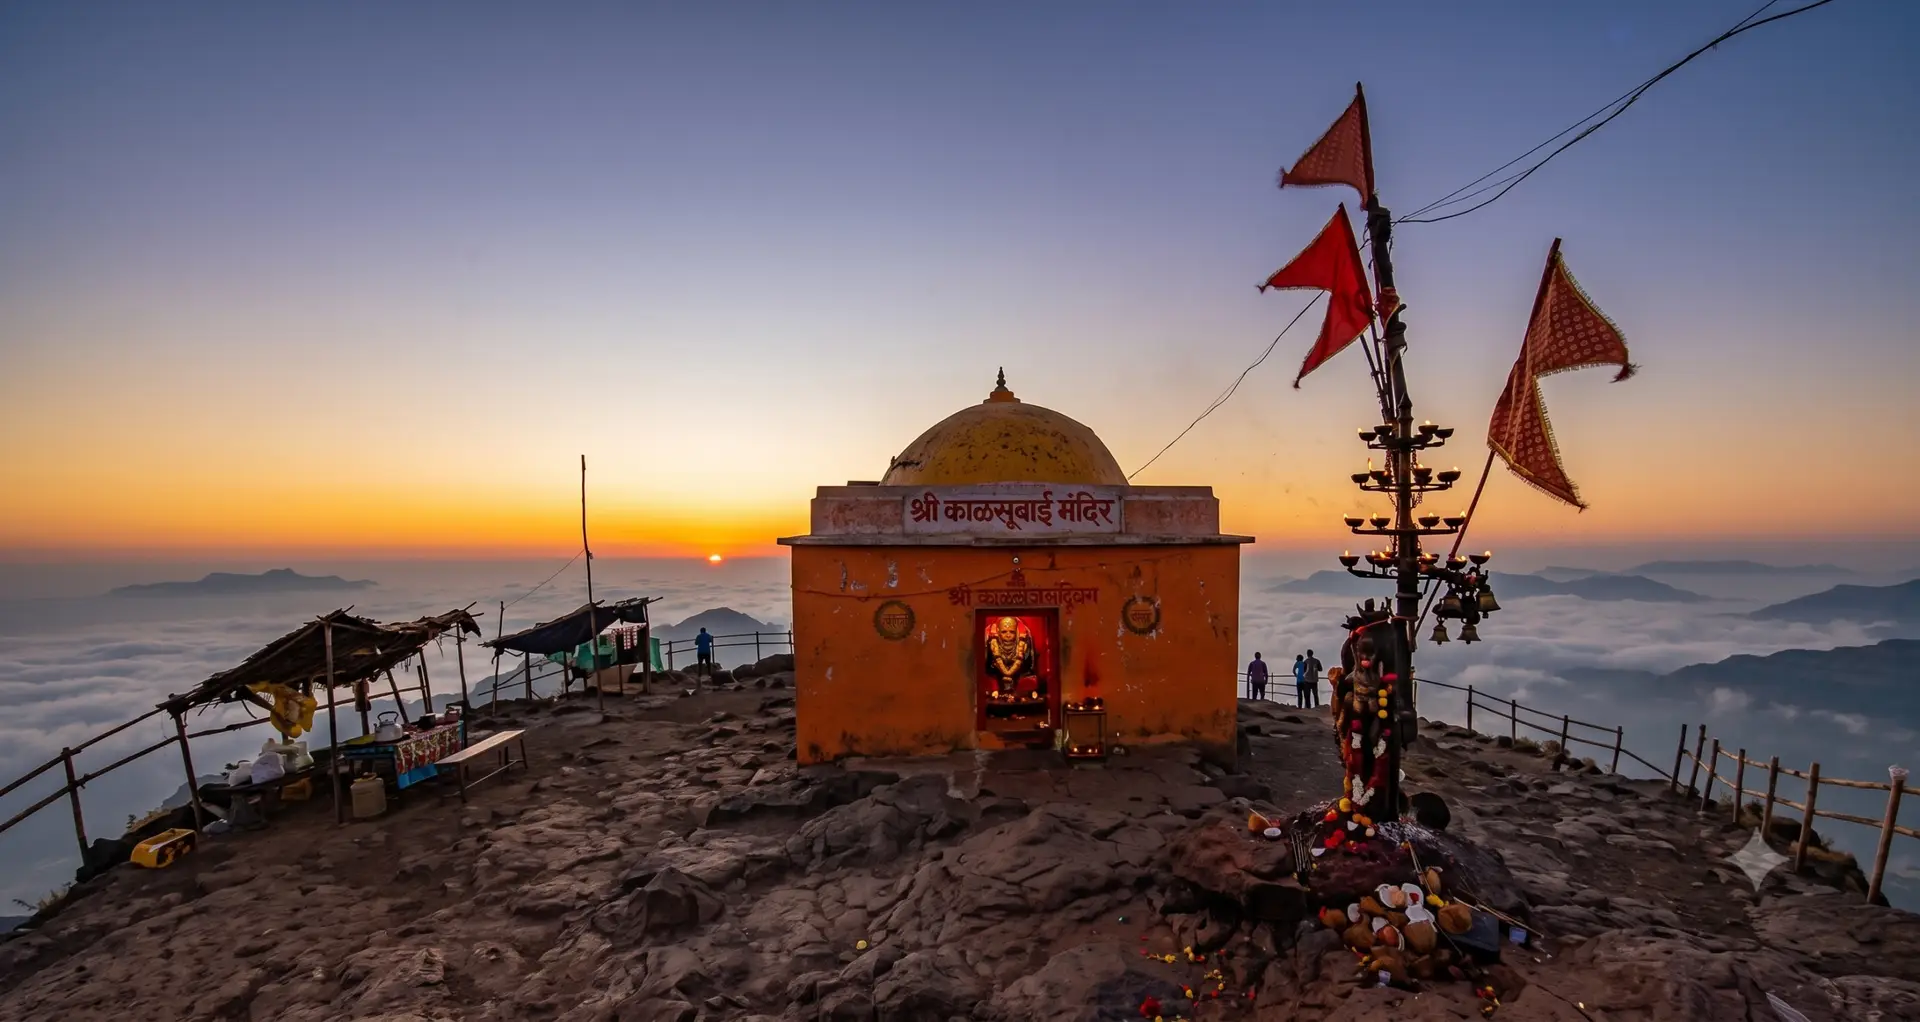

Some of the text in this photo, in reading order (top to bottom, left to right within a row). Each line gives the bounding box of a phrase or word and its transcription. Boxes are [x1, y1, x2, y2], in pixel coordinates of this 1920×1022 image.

[910, 491, 1115, 530] श्री काळसूबाई मंदिर
